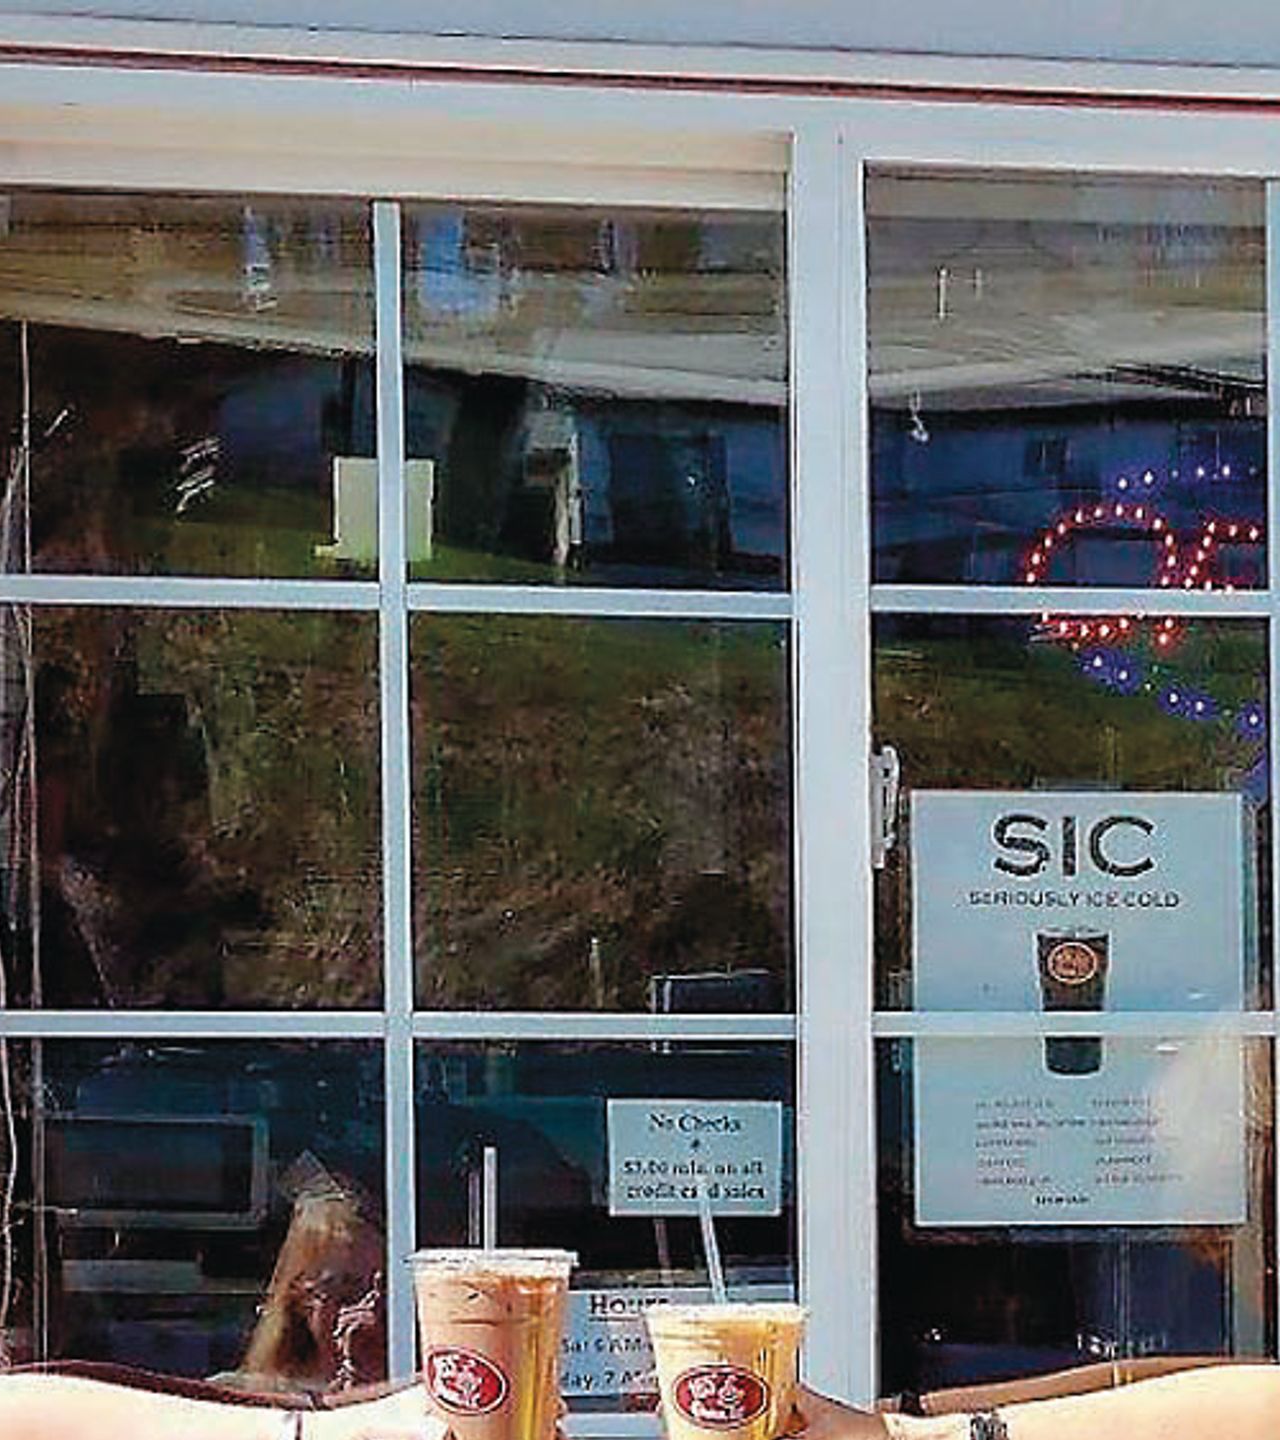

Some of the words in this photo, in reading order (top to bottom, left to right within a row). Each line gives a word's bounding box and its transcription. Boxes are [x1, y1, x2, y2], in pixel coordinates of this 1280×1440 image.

[993, 814, 1154, 877] SIC
[970, 890, 1080, 907] SERIOUSLY
[1086, 891, 1120, 907] ICE
[1125, 891, 1180, 908] COLD
[649, 1112, 673, 1133] No
[677, 1112, 742, 1134] Checks
[714, 1161, 737, 1175] on
[741, 1159, 765, 1175] all
[626, 1183, 678, 1200] credit
[680, 1182, 721, 1200] cad
[724, 1182, 767, 1200] sales
